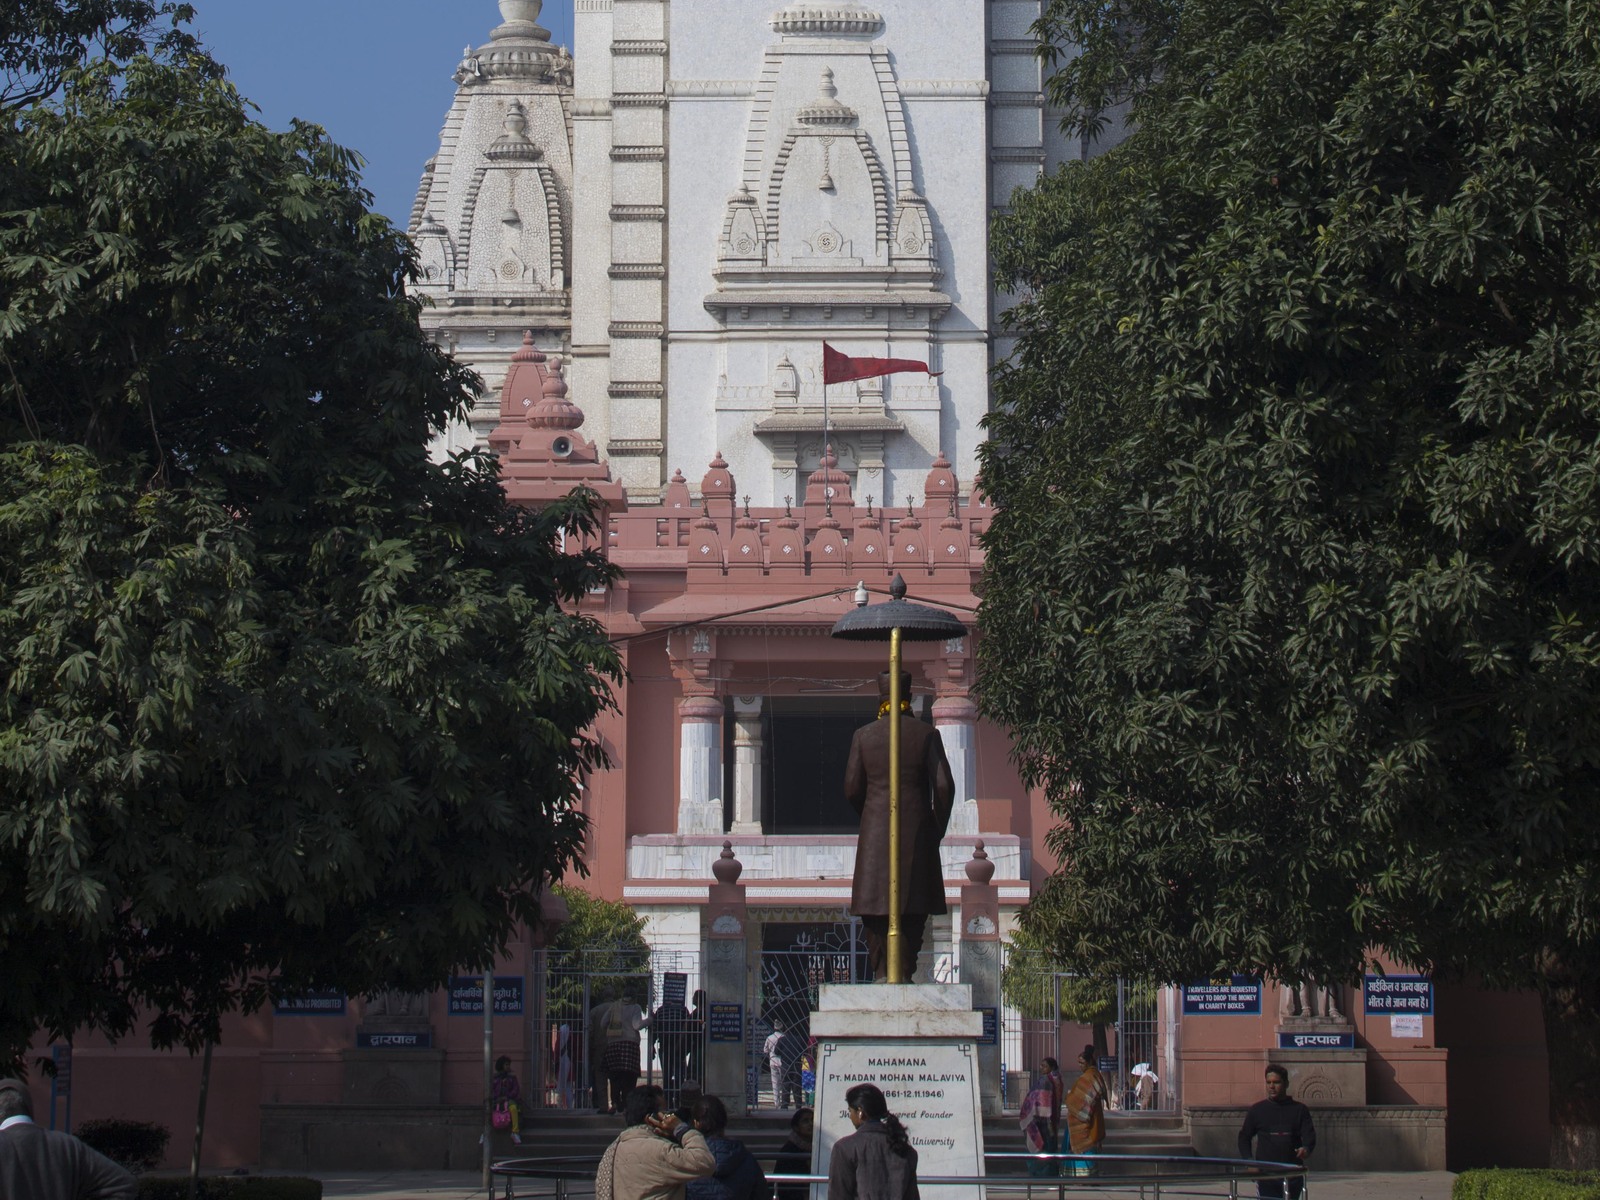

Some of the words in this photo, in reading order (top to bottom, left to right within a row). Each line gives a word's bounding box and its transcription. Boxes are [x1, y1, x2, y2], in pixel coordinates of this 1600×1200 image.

[305, 999, 310, 1008] IS
[310, 999, 342, 1008] PROHIBITED
[1294, 1036, 1342, 1046] द्वारपाल
[868, 1058, 926, 1066] MAHAMANA
[844, 1074, 876, 1082] MADAN
[880, 1074, 914, 1082] MOHAN
[919, 1074, 966, 1082] MALAVIYA
[840, 1110, 850, 1118] Th
[920, 1110, 954, 1118] Founder
[912, 1137, 954, 1150] University
